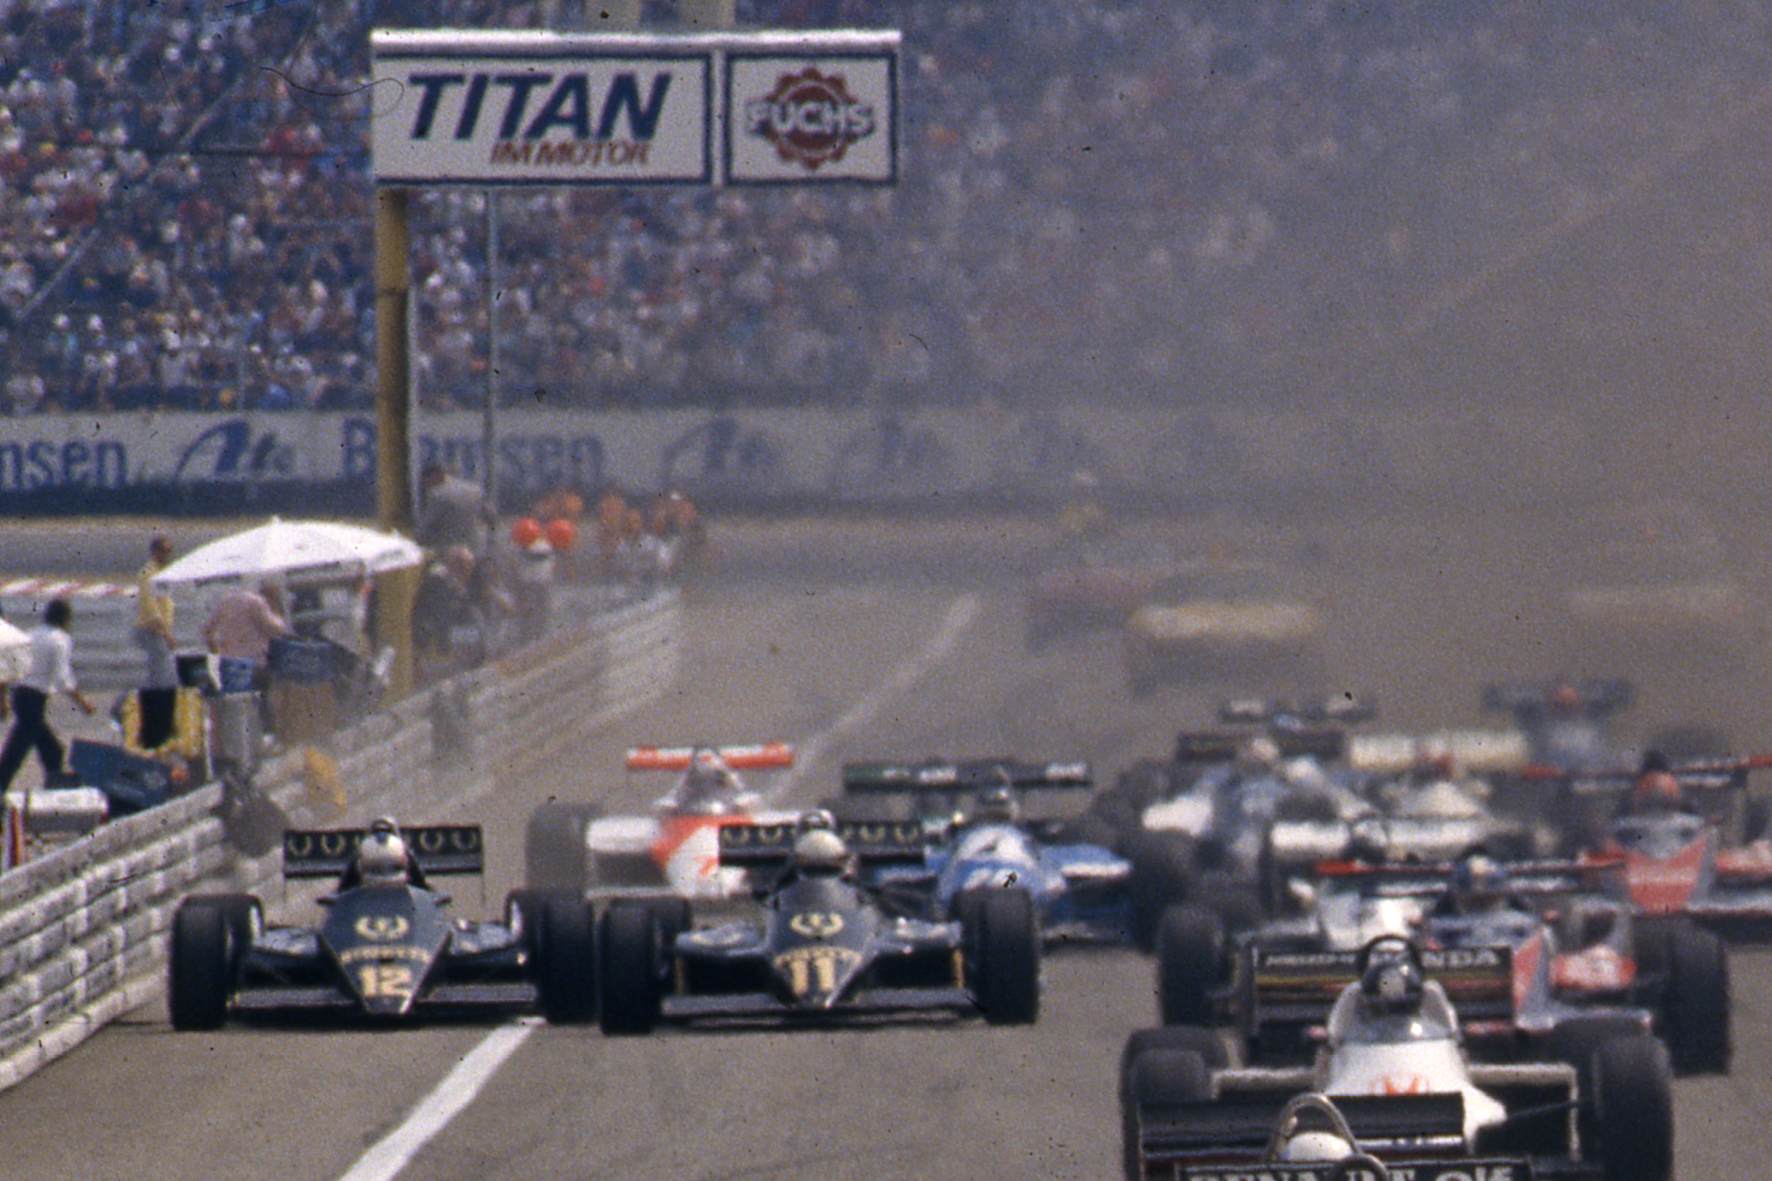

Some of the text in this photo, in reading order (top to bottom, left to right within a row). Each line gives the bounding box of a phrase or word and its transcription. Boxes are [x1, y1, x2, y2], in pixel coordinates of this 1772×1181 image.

[407, 72, 672, 140] TITAN
[746, 99, 875, 137] FUCHS
[360, 965, 412, 997] 12
[791, 957, 837, 996] 11
